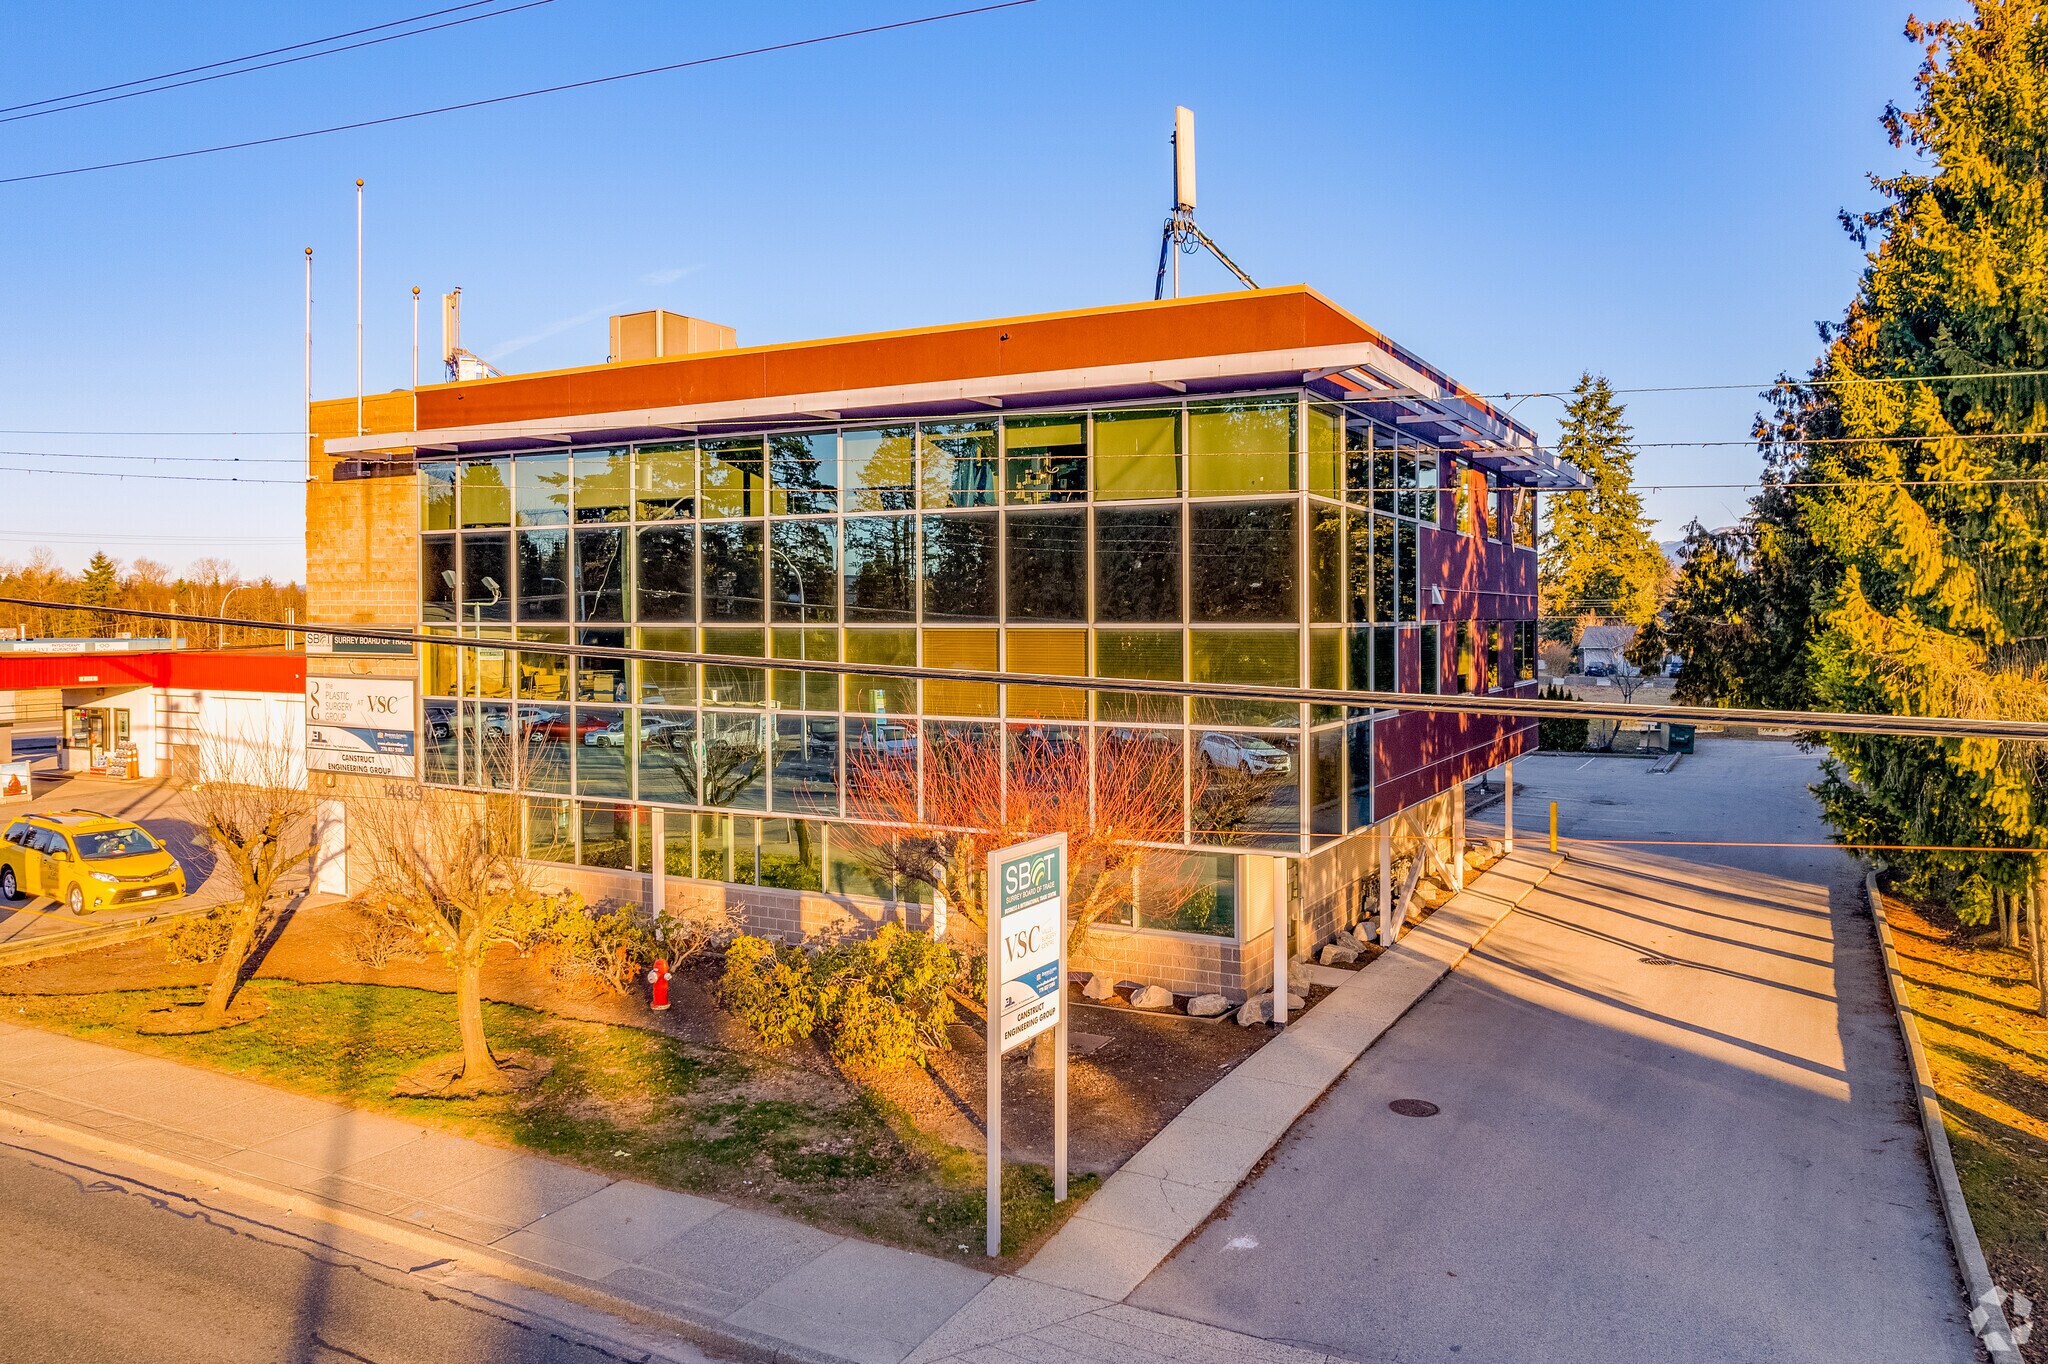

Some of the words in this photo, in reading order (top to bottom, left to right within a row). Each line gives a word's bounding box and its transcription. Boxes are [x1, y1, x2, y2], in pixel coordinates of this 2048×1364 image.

[334, 636, 358, 644] SURREY
[325, 691, 350, 701] PLASTIC
[325, 701, 352, 712] SURGERY
[367, 695, 398, 714] VSC
[325, 712, 347, 722] GROUP
[342, 754, 375, 763] CANSTRUCT
[328, 763, 368, 773] ENGINEERING
[370, 767, 391, 775] GROUP
[382, 783, 422, 801] 14439
[1006, 892, 1023, 904] SURREY
[1023, 887, 1037, 898] BOARD
[1036, 884, 1043, 893] OF
[1042, 881, 1055, 891] TRADE
[1004, 925, 1041, 962] VSC
[1017, 1002, 1045, 1021] CANSTRUCT
[1004, 1016, 1039, 1040] ENGINEERING
[1039, 1007, 1056, 1021] GROUP
